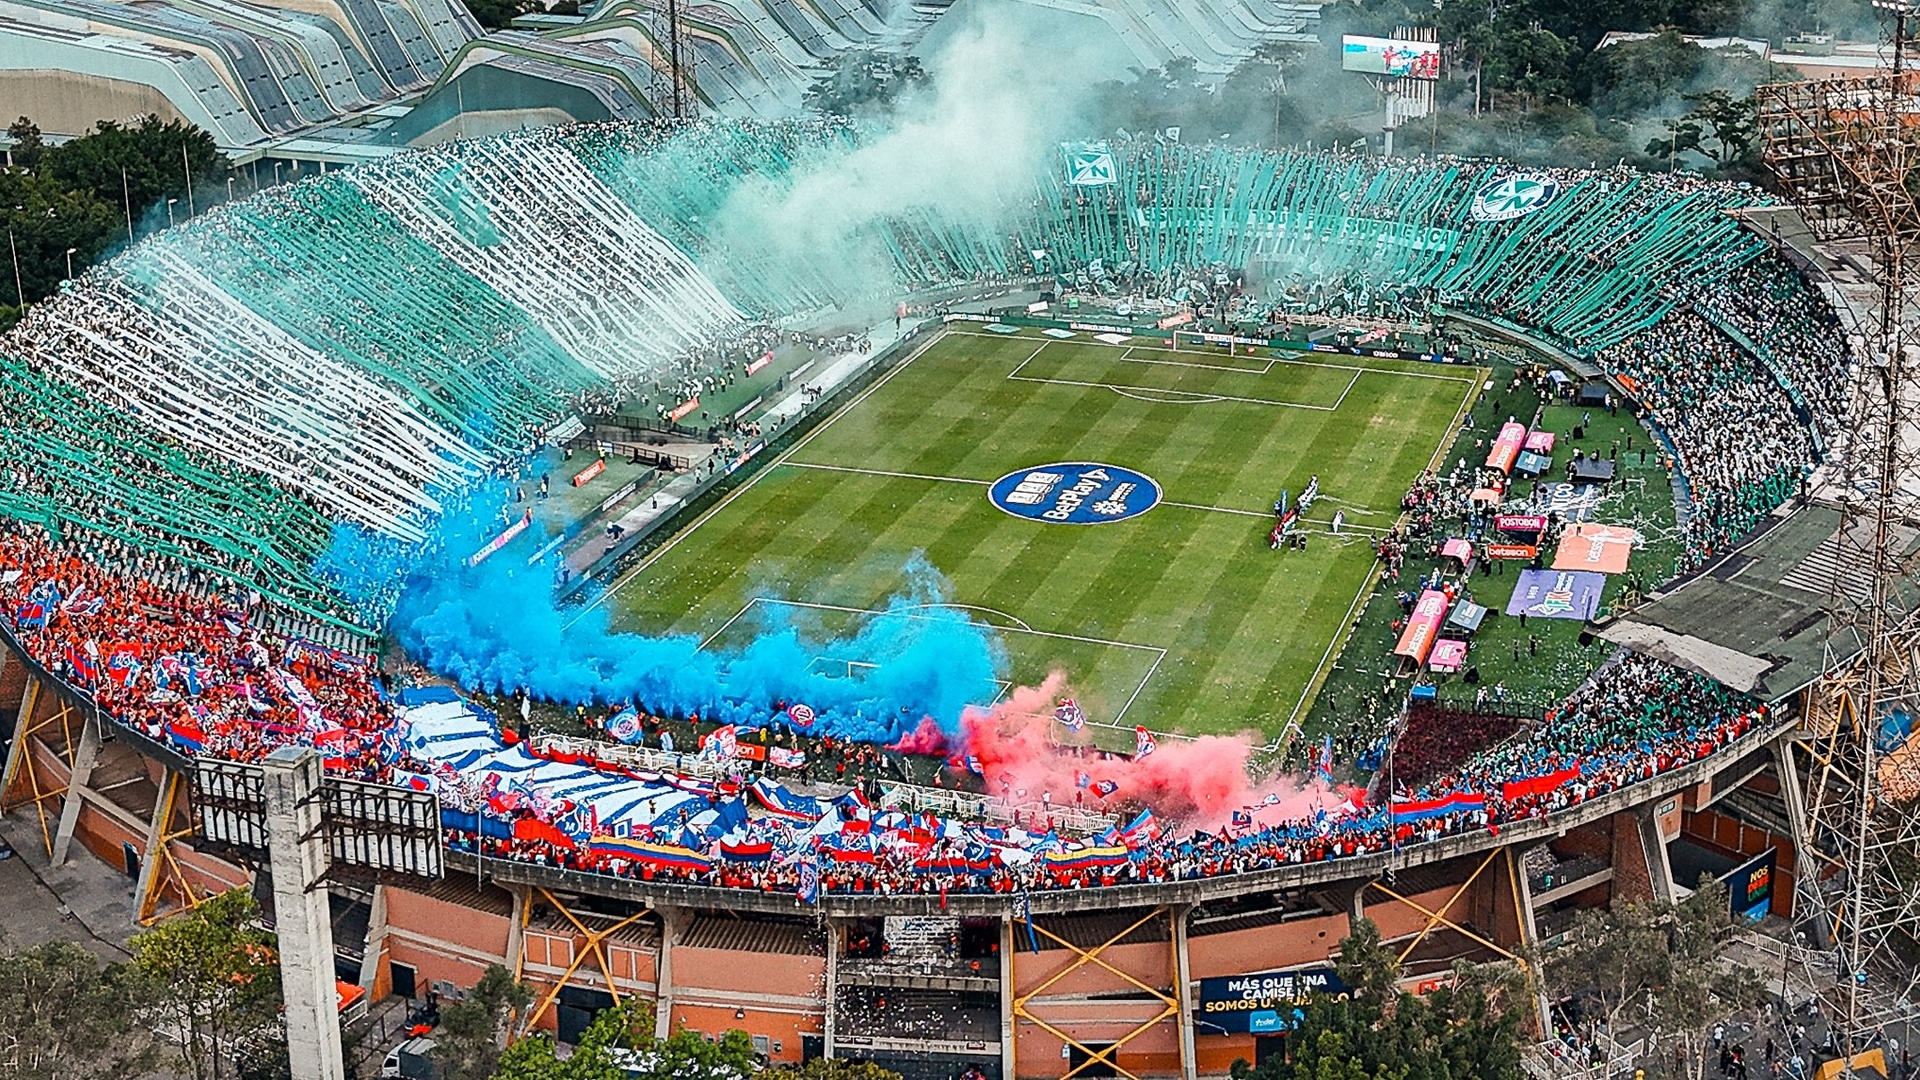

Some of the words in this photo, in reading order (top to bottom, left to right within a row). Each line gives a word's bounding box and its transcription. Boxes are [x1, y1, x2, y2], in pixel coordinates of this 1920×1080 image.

[1042, 477, 1102, 521] BetPlay
[1488, 545, 1529, 557] betsson
[1749, 865, 1768, 883] NOS
[1229, 978, 1260, 992] MÁS
[1262, 976, 1293, 989] QUE
[1205, 999, 1258, 1013] SOMOS
